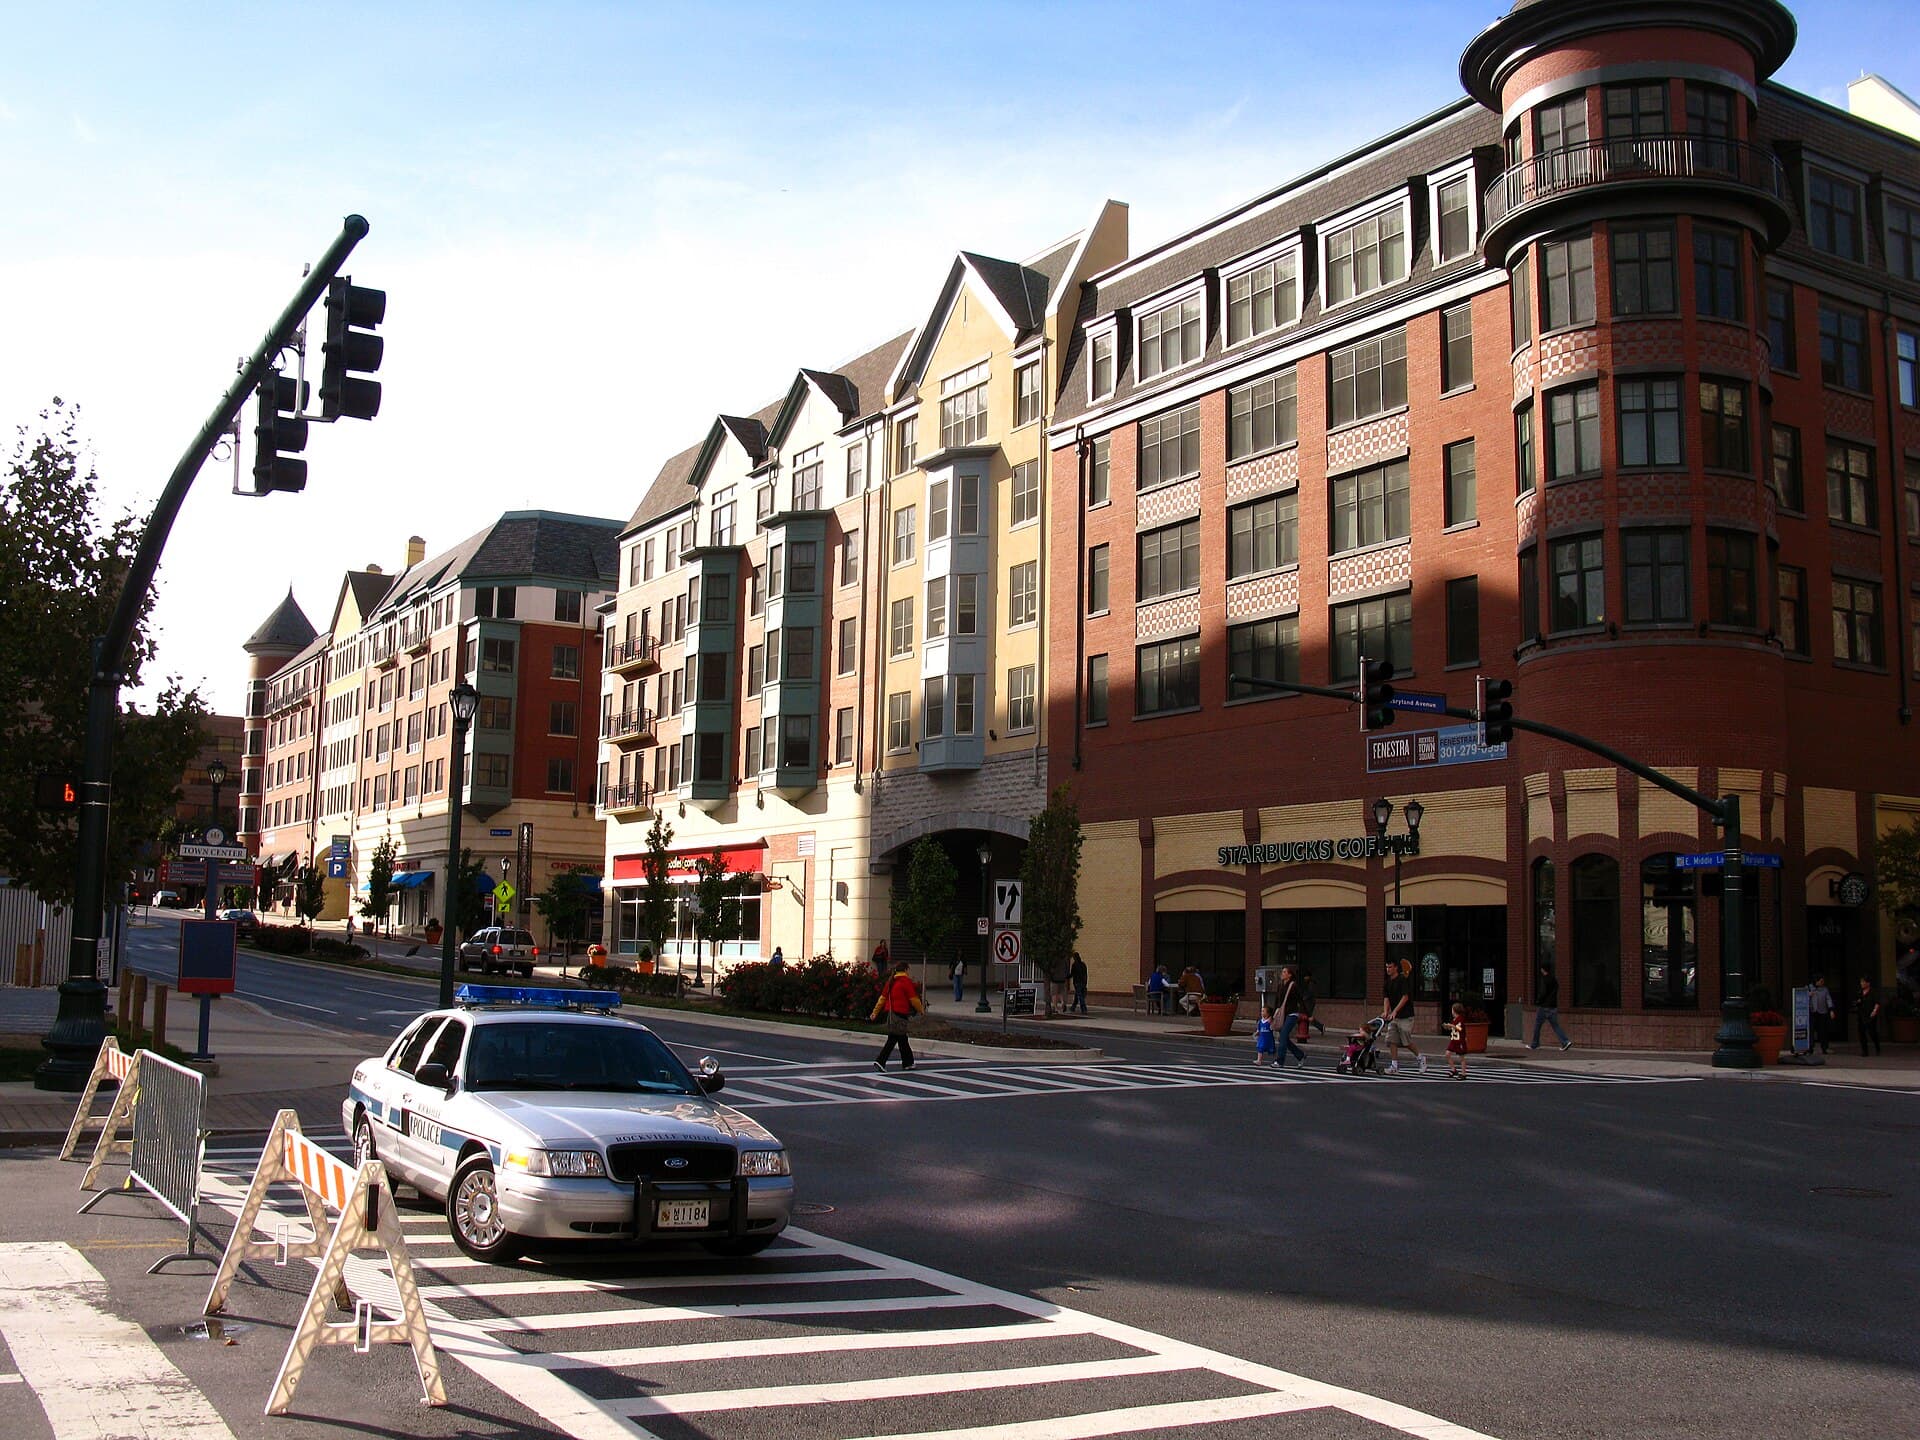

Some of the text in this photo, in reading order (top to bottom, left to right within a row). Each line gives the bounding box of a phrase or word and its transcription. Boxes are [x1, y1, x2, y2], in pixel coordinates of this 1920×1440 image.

[1414, 699, 1437, 708] Avenue
[1372, 739, 1410, 760] FENESTRA
[1418, 743, 1436, 753] TOWN
[183, 846, 244, 857] TOWN CENTER
[1217, 834, 1420, 866] STARBUCKS COF
[1693, 856, 1713, 865] Middle
[333, 864, 342, 875] P
[1391, 933, 1407, 941] ONLY
[412, 1116, 441, 1145] POLICE
[615, 1133, 679, 1142] ROCKVILLE
